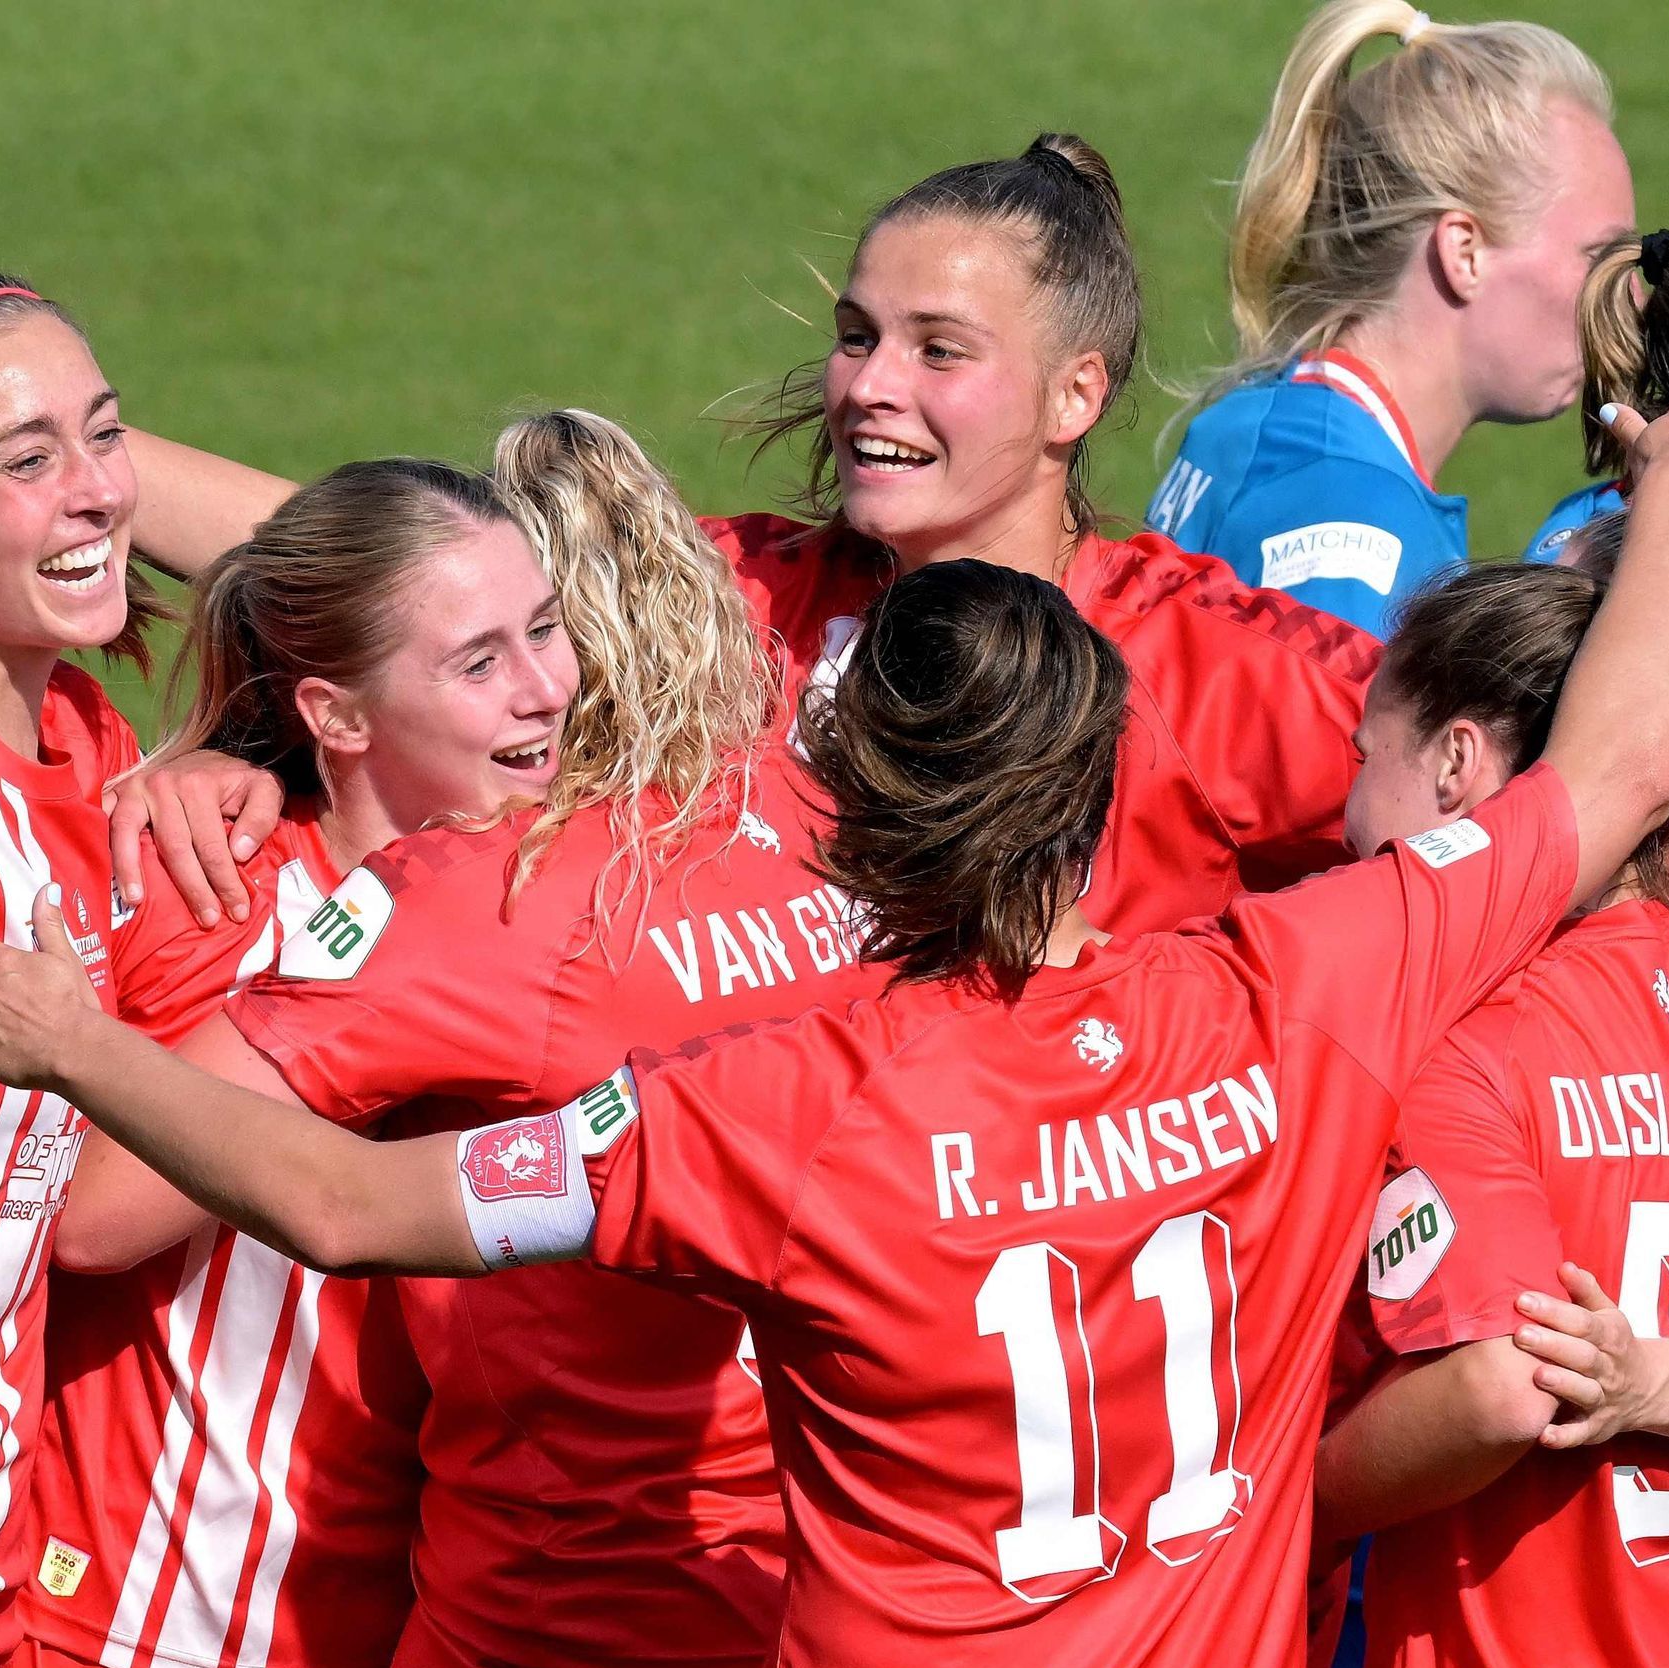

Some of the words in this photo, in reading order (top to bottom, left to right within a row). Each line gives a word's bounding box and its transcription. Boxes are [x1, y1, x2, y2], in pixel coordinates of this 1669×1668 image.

[1269, 529, 1393, 565] MATCHIS
[306, 896, 364, 960] OTO
[647, 907, 797, 1004] VAN
[579, 1079, 627, 1136] OTO
[931, 1131, 999, 1220] R.
[1020, 1063, 1279, 1212] JANSEN
[1372, 1202, 1439, 1280] TOTO
[974, 1209, 1254, 1604] 11
[55, 1553, 76, 1568] PRO
